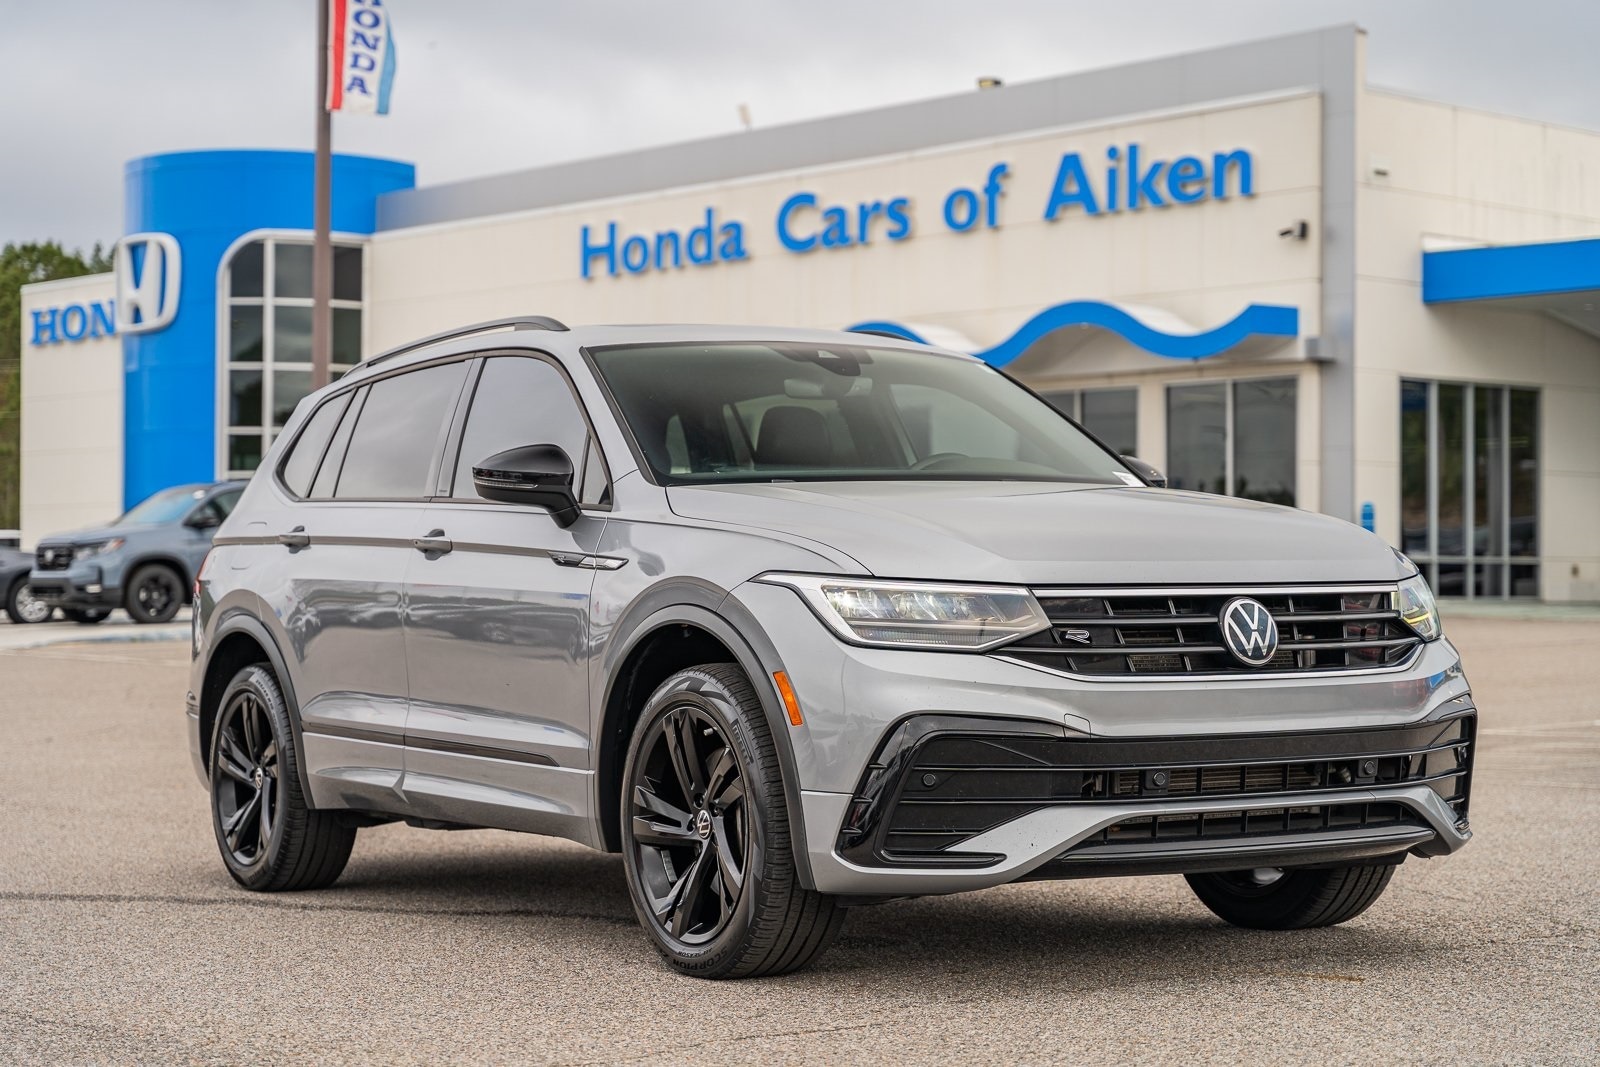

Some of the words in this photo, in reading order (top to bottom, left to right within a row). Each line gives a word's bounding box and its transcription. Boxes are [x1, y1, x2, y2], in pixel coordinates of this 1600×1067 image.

[580, 206, 748, 279] Honda
[776, 191, 911, 253] Cars
[943, 163, 1008, 232] of
[1043, 143, 1253, 221] Aiken
